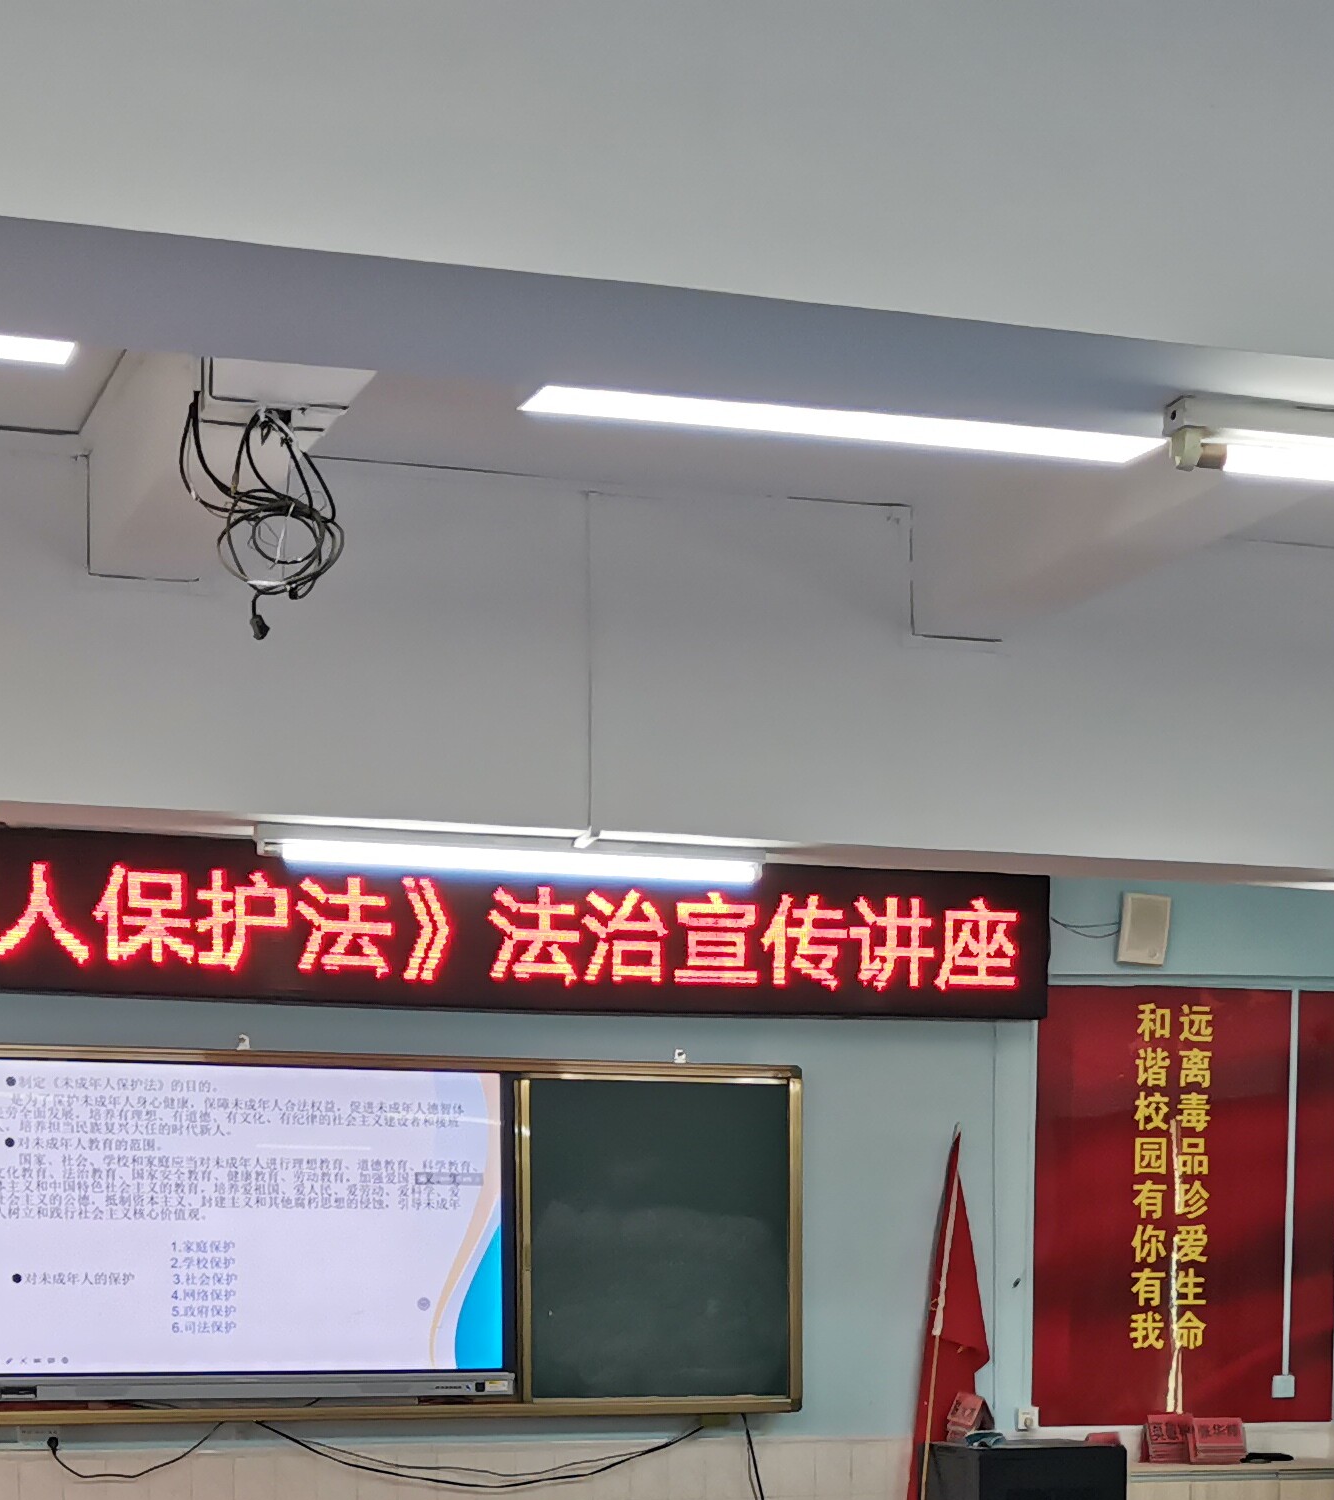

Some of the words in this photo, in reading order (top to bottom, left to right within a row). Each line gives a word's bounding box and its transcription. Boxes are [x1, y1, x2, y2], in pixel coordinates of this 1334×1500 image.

[1128, 1002, 1172, 1351] 和谐校园有你有我
[1173, 1003, 1214, 1350] 远离毒品珍爱生命
